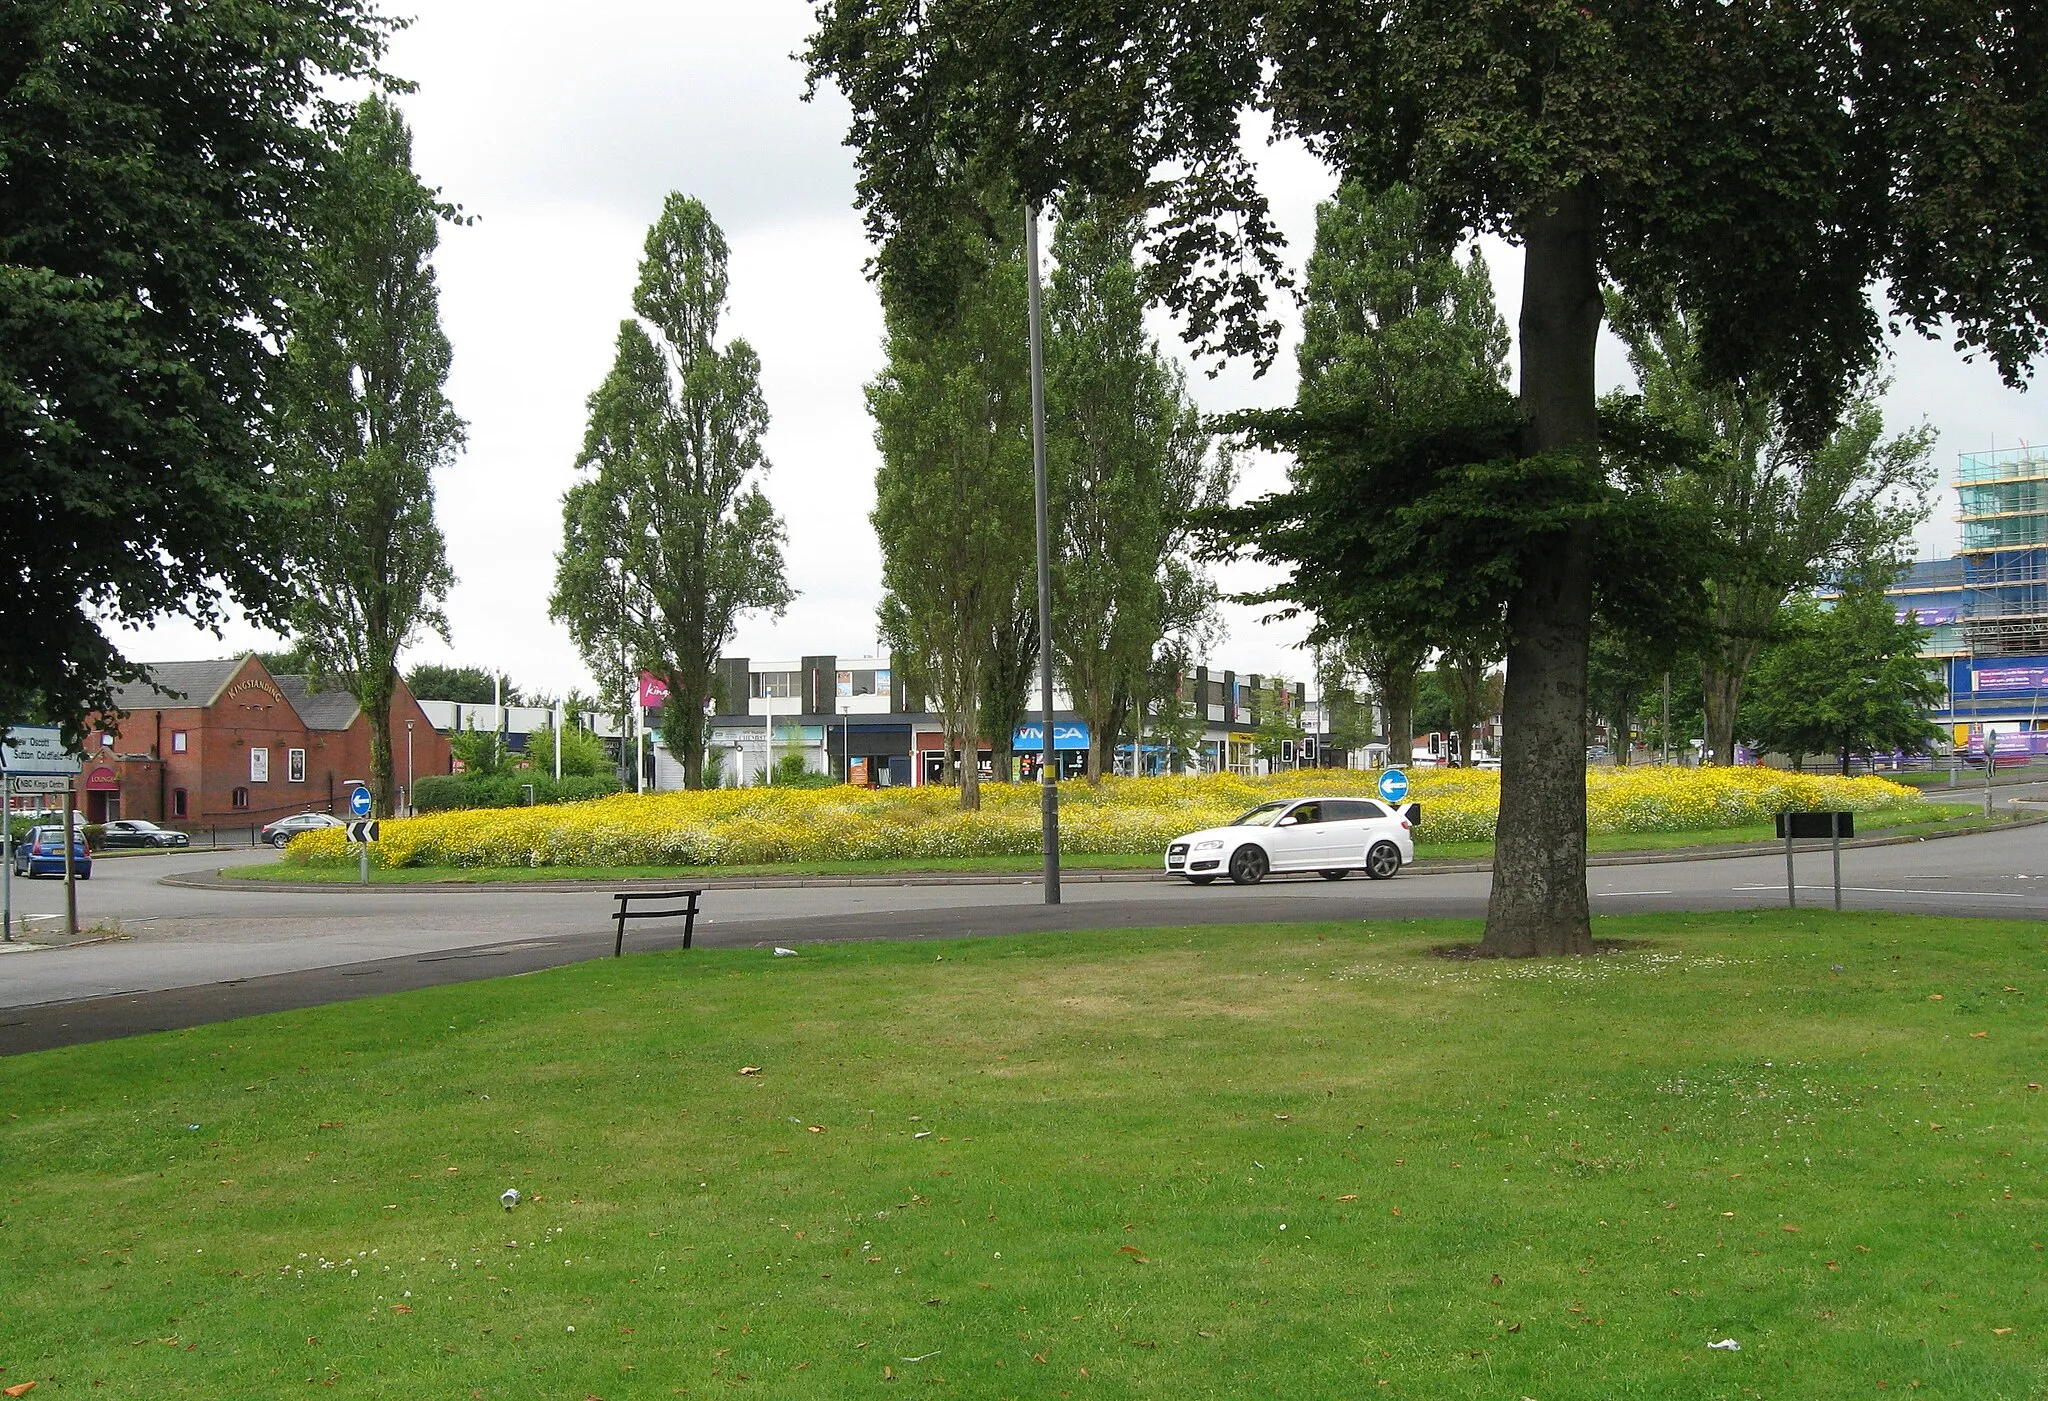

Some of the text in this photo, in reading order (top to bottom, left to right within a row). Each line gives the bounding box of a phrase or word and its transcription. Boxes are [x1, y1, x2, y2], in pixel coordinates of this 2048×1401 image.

[228, 679, 282, 702] KINGSTANDING
[1019, 727, 1083, 740] YMCA
[30, 737, 50, 748] Oscott
[14, 749, 34, 760] Sutton
[37, 750, 64, 761] Coldfield
[34, 780, 48, 790] Kings
[49, 781, 65, 789] Centre
